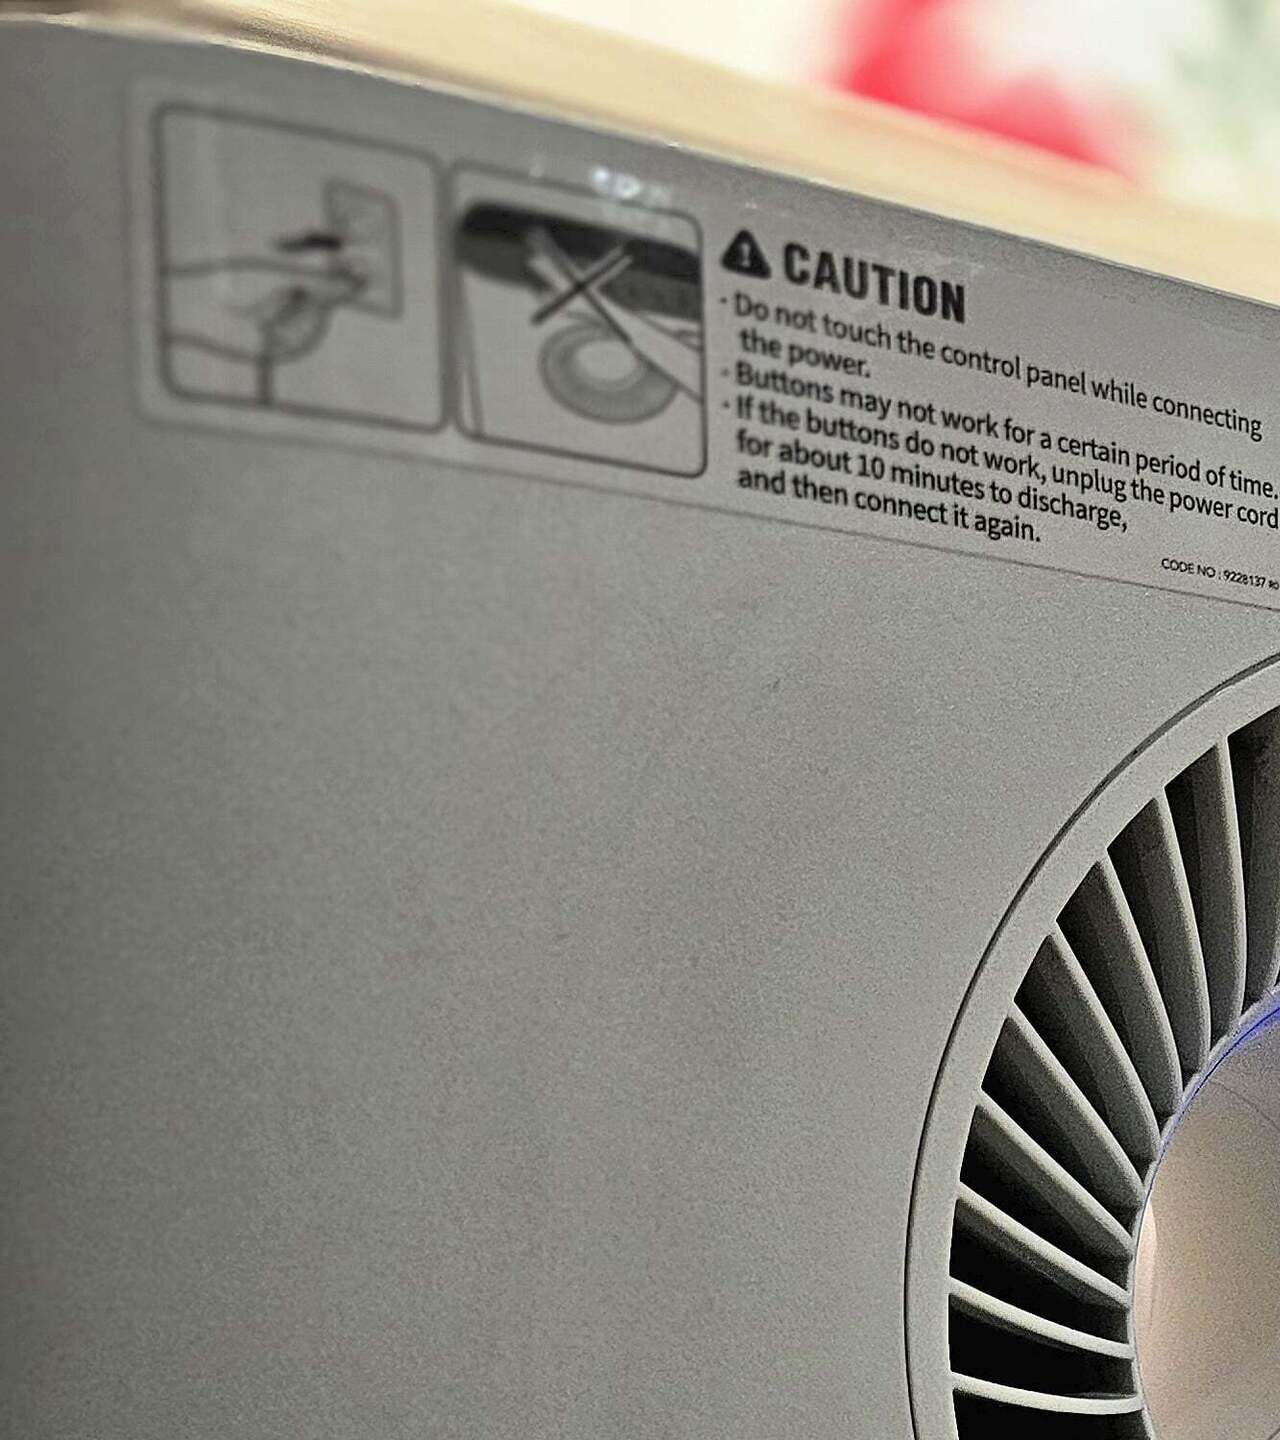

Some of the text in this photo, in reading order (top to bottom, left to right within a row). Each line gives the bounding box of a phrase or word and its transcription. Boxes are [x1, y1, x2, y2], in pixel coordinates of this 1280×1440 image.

[784, 242, 965, 324] CAUTION
[735, 290, 1263, 442] Do not touch the control panel while connecting
[740, 327, 871, 378] the power.
[735, 359, 1279, 500] Buttons may not work for a certain period of time.
[736, 394, 1279, 530] If the buttons do not work, unplug the power cord
[735, 427, 1128, 533] for about 10 minutes to discharge,
[737, 468, 1042, 541] and then connect it again.
[1161, 558, 1195, 575] CODE
[1197, 565, 1216, 579] NO
